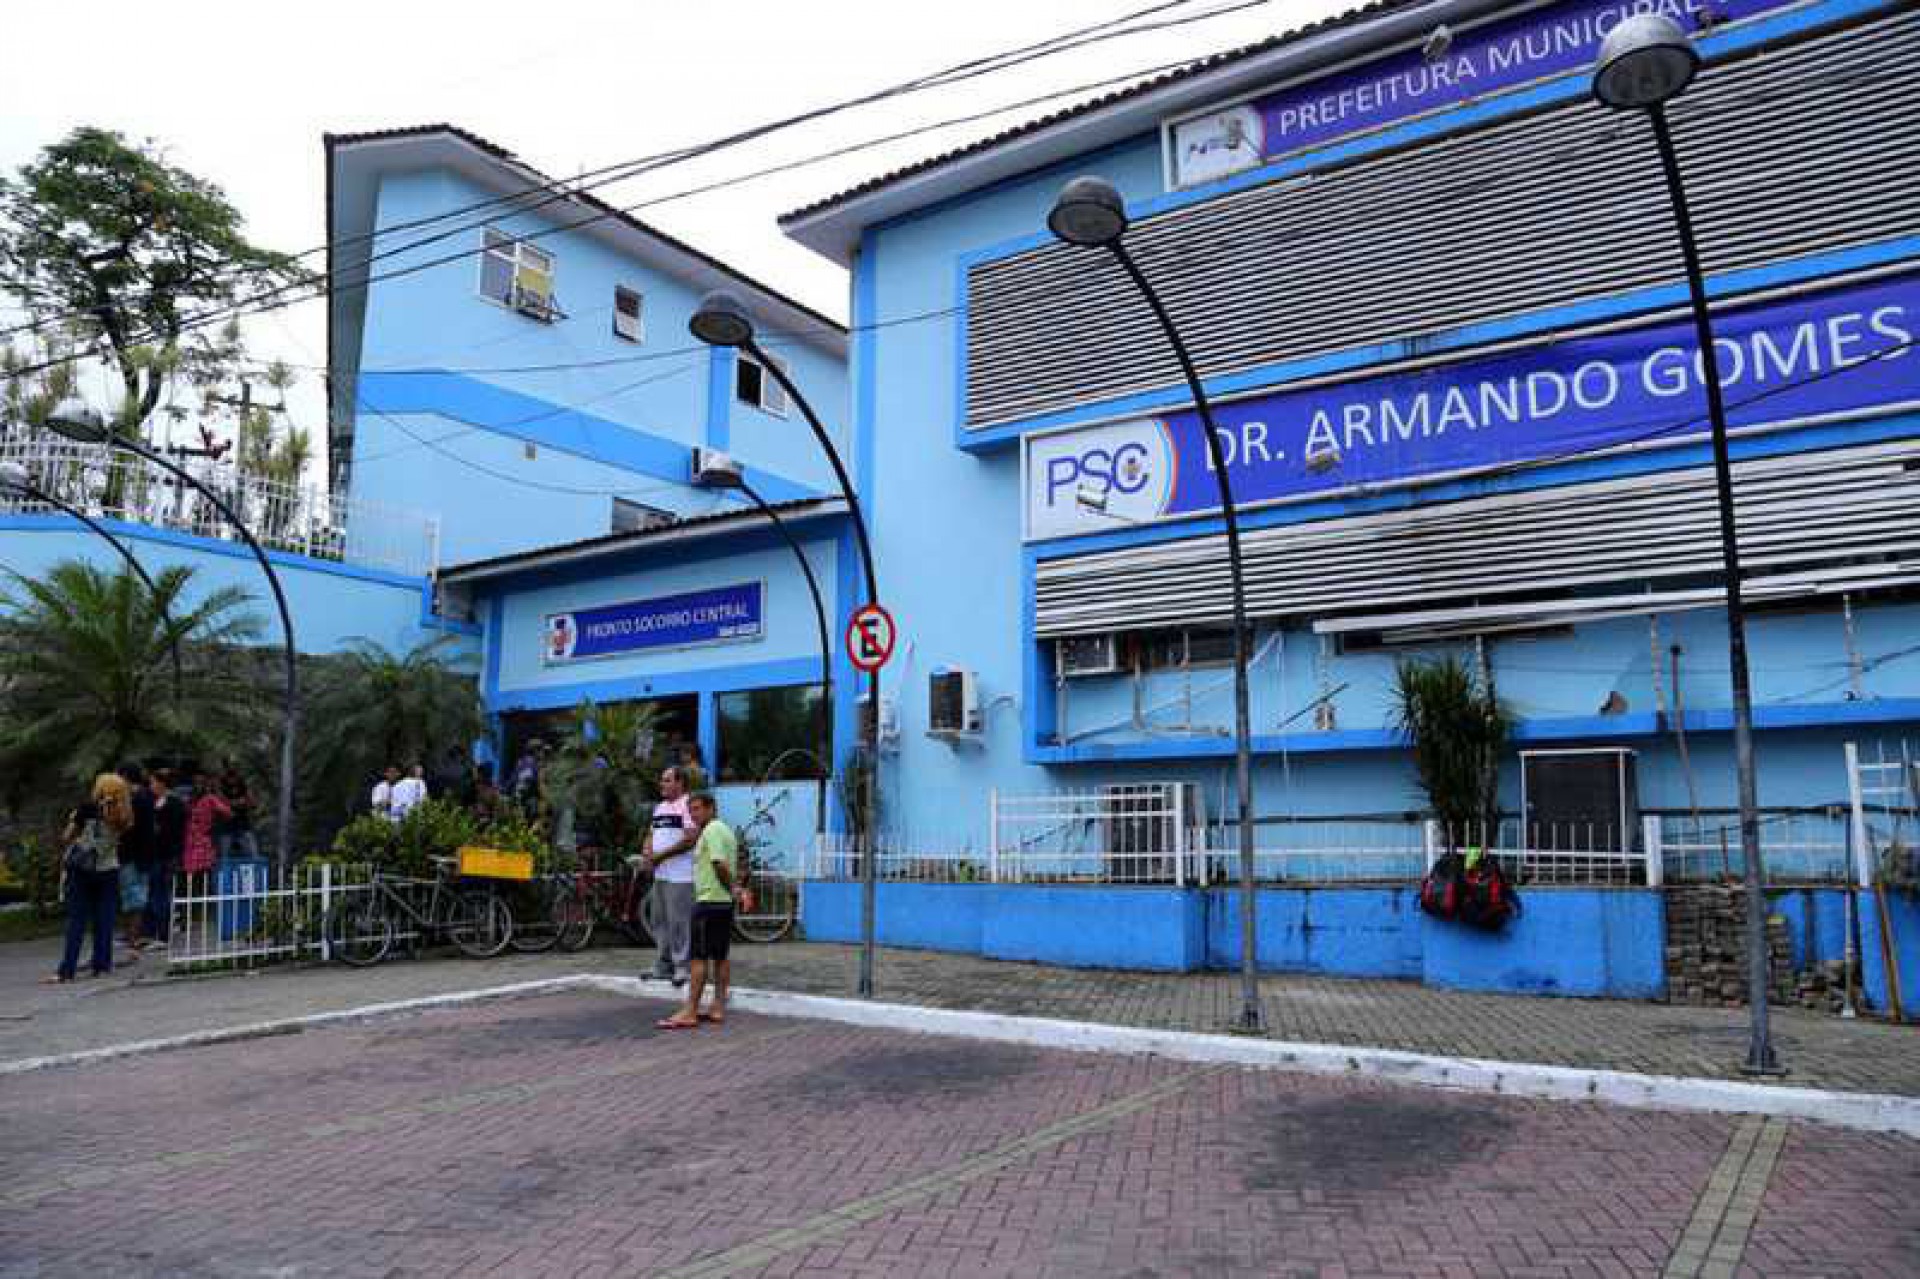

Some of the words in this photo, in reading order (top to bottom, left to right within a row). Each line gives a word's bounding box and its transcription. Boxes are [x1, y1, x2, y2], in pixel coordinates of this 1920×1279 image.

[1281, 57, 1476, 135] PREFEITURA
[1206, 420, 1285, 472] DR.
[1305, 361, 1619, 461] ARMANDO
[1642, 305, 1912, 397] GOMES
[1047, 442, 1149, 507] PSC
[587, 616, 631, 641] PRONTO
[635, 608, 690, 634] SOCORRO
[693, 599, 750, 624] CENTRAL
[862, 618, 881, 659] E
